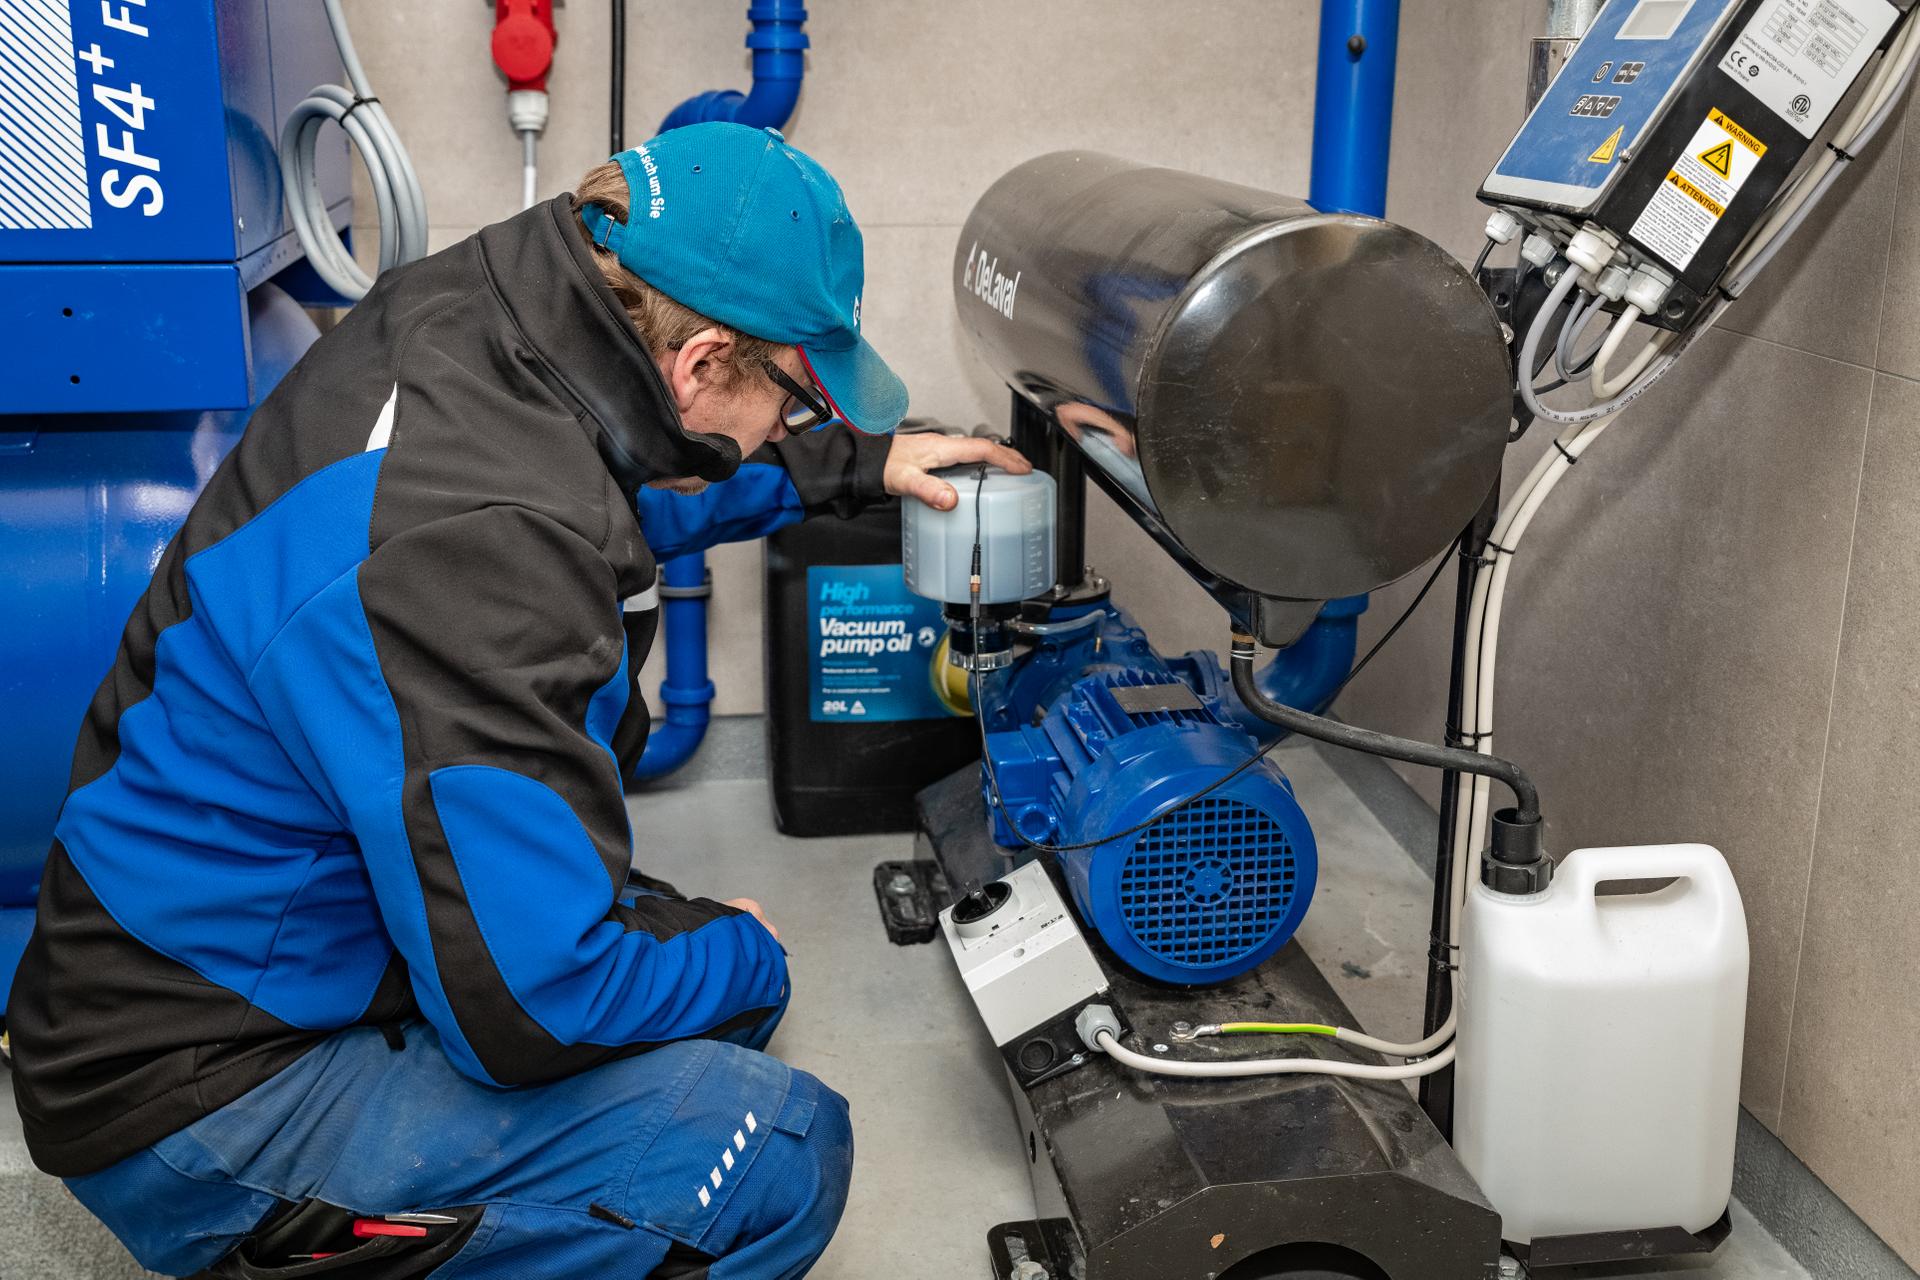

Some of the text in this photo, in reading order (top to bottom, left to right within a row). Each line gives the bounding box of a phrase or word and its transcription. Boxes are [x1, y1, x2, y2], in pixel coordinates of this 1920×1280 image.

[79, 43, 164, 217] SF4+
[1725, 122, 1761, 152] WARNING
[641, 155, 658, 176] sich
[649, 176, 661, 196] um
[650, 197, 665, 219] Sie
[1680, 183, 1721, 216] ATTENTION
[974, 249, 1022, 321] DeLaval
[820, 581, 870, 605] High
[820, 604, 914, 618] performance
[820, 618, 905, 636] Vacuum
[820, 633, 913, 658] pump oil
